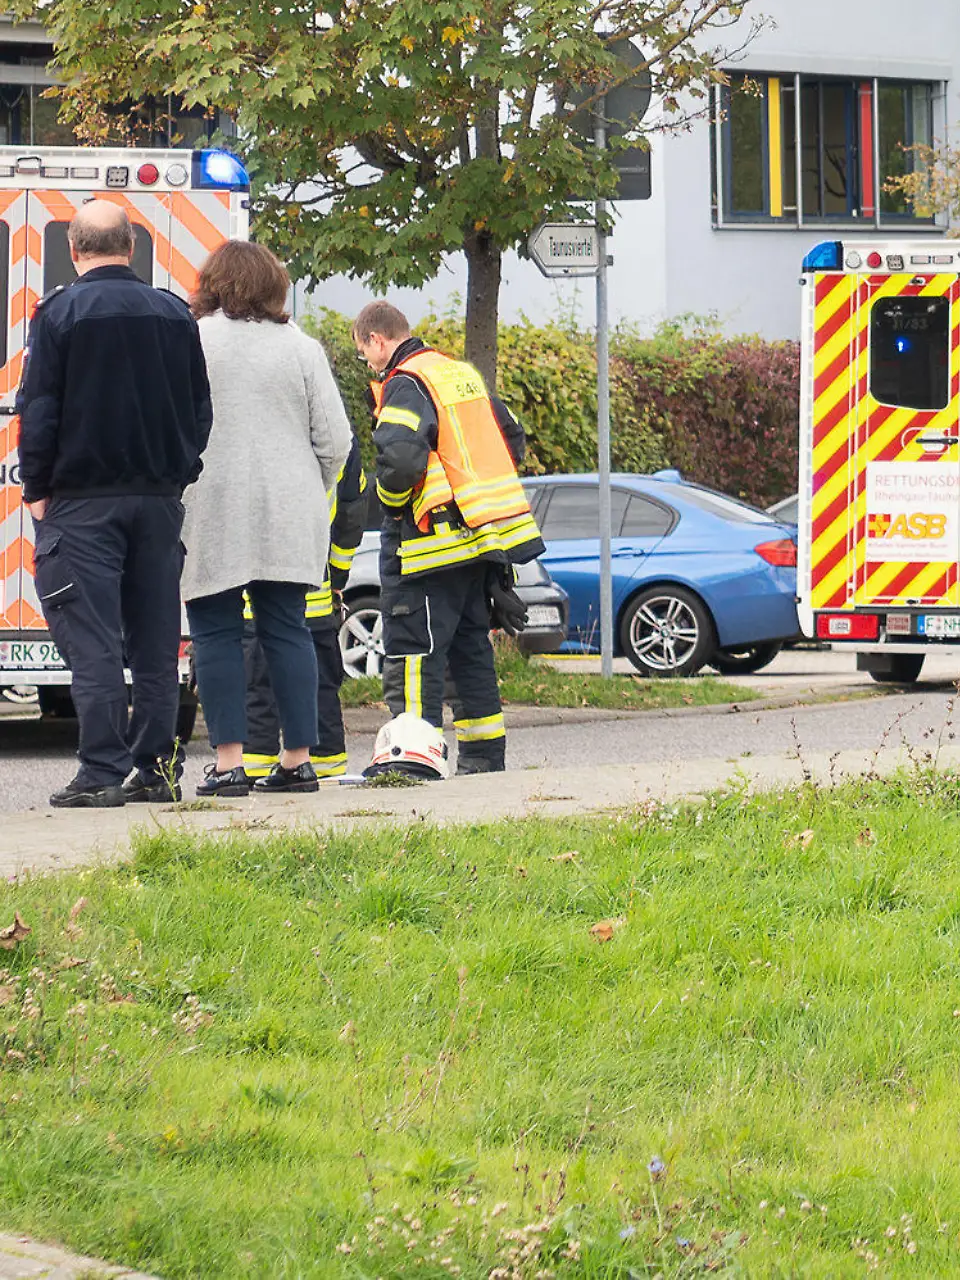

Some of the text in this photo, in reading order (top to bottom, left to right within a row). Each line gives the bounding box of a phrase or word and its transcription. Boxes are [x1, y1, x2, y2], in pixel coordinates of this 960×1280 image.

[548, 235, 594, 257] Taunusviertel
[886, 512, 948, 540] ASB
[926, 617, 935, 630] F
